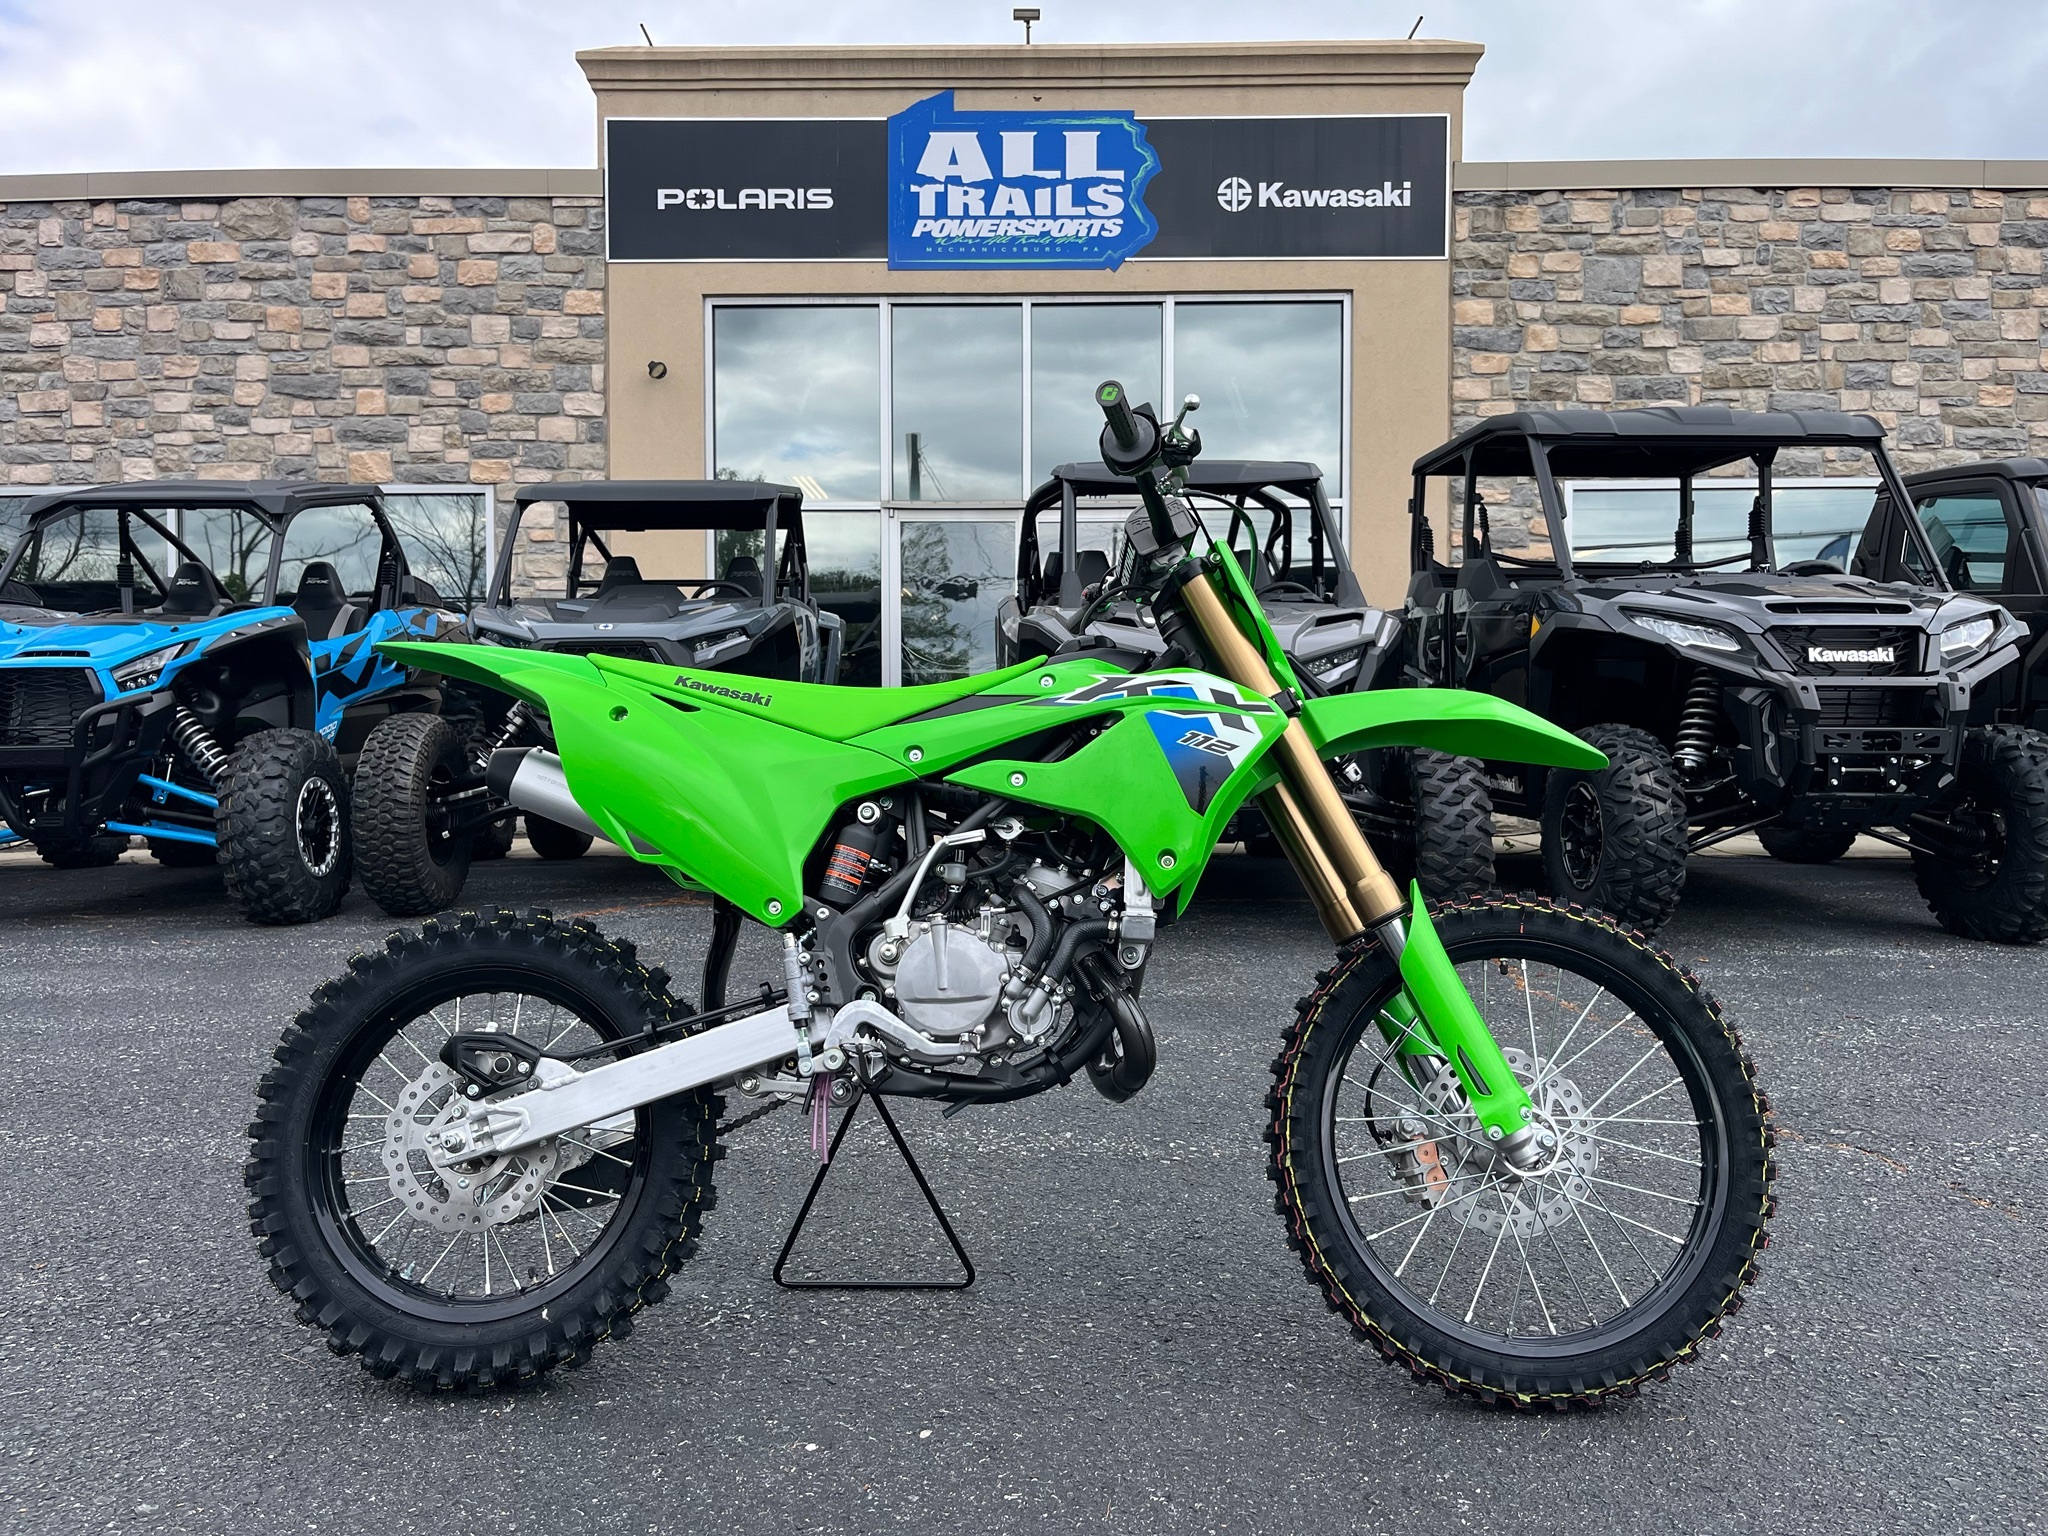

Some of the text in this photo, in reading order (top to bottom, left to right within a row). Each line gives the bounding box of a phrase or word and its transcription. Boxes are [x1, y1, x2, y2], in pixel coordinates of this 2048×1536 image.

[915, 131, 1125, 183] ALL
[657, 188, 834, 210] POLARIS
[910, 184, 1125, 217] TRAILS
[1258, 181, 1412, 208] Kawasaki
[911, 218, 1124, 238] POWERSPORTS
[983, 235, 1013, 246] All
[1807, 647, 1895, 662] Kawasaki
[674, 675, 773, 707] Kawasaki
[1176, 730, 1240, 756] 112
